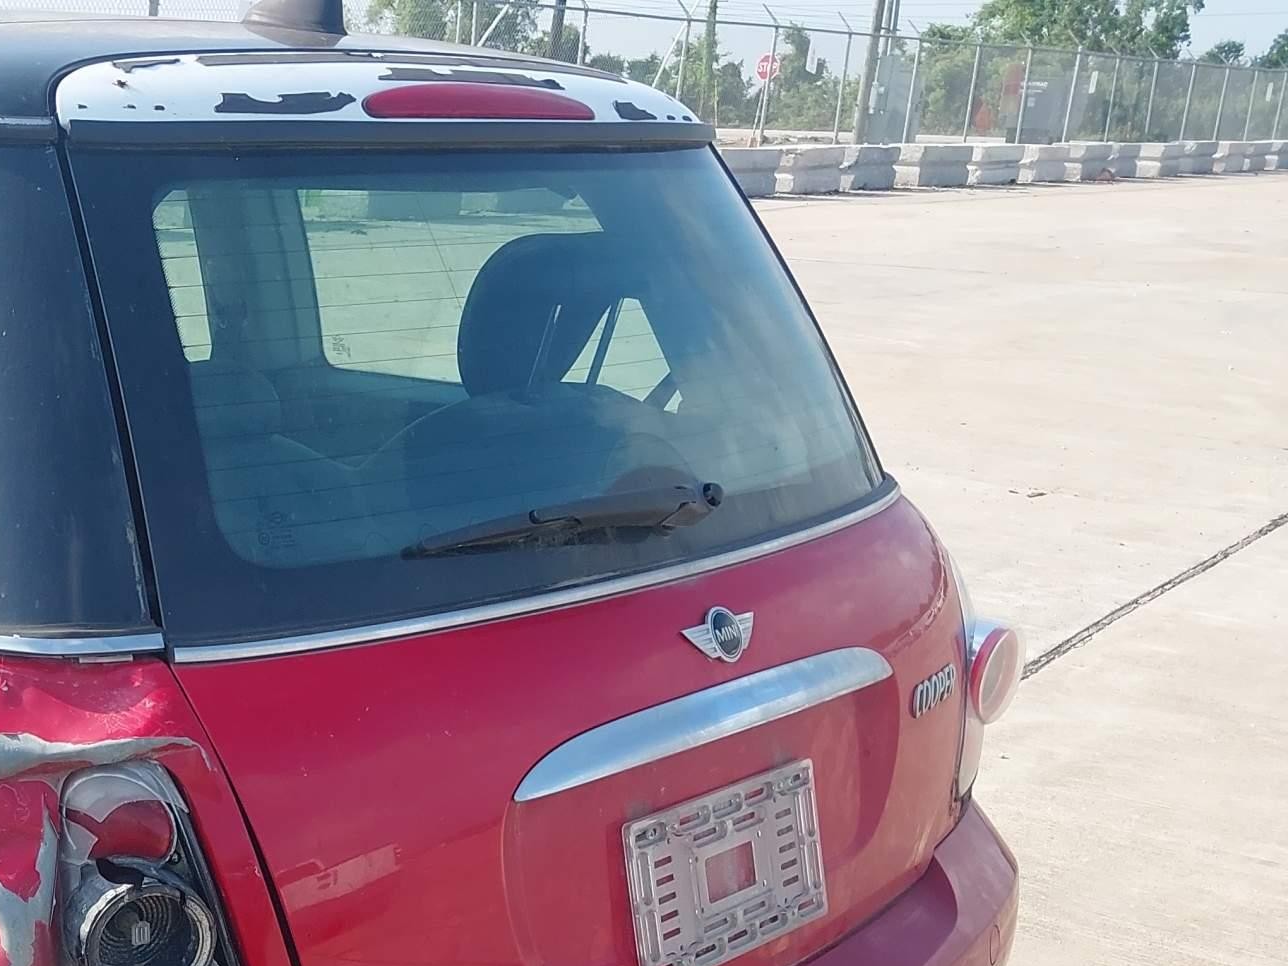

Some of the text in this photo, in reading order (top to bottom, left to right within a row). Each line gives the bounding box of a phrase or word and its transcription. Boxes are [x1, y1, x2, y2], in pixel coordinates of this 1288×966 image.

[758, 62, 777, 72] STP
[714, 623, 740, 644] MINI
[913, 663, 956, 719] COOPER
